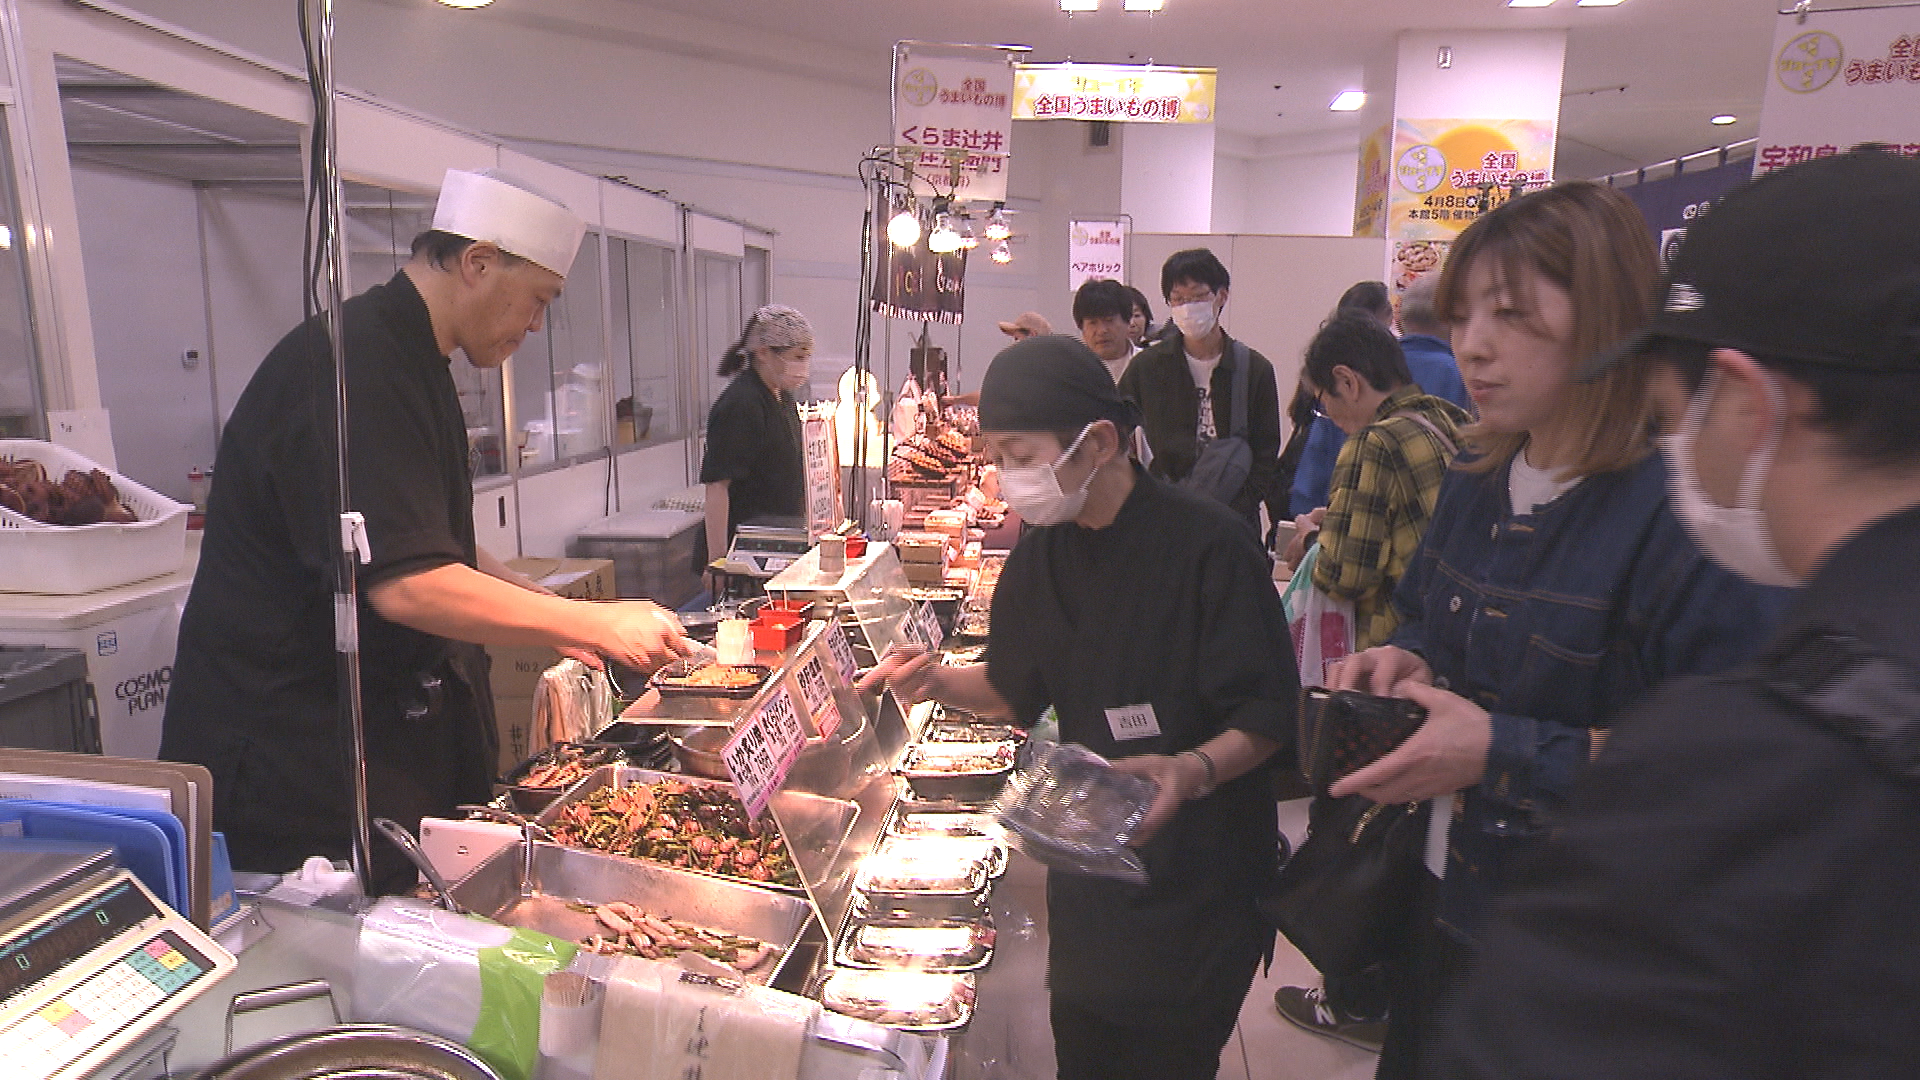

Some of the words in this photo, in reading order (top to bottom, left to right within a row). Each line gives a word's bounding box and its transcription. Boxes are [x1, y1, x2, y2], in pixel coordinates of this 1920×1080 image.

[1890, 38, 1920, 58] 全
[1036, 95, 1179, 119] 全国うまいもの博
[902, 125, 1003, 151] くらま辻井
[1483, 153, 1516, 169] 全国
[115, 666, 171, 700] COSMO
[128, 687, 165, 716] PLAN
